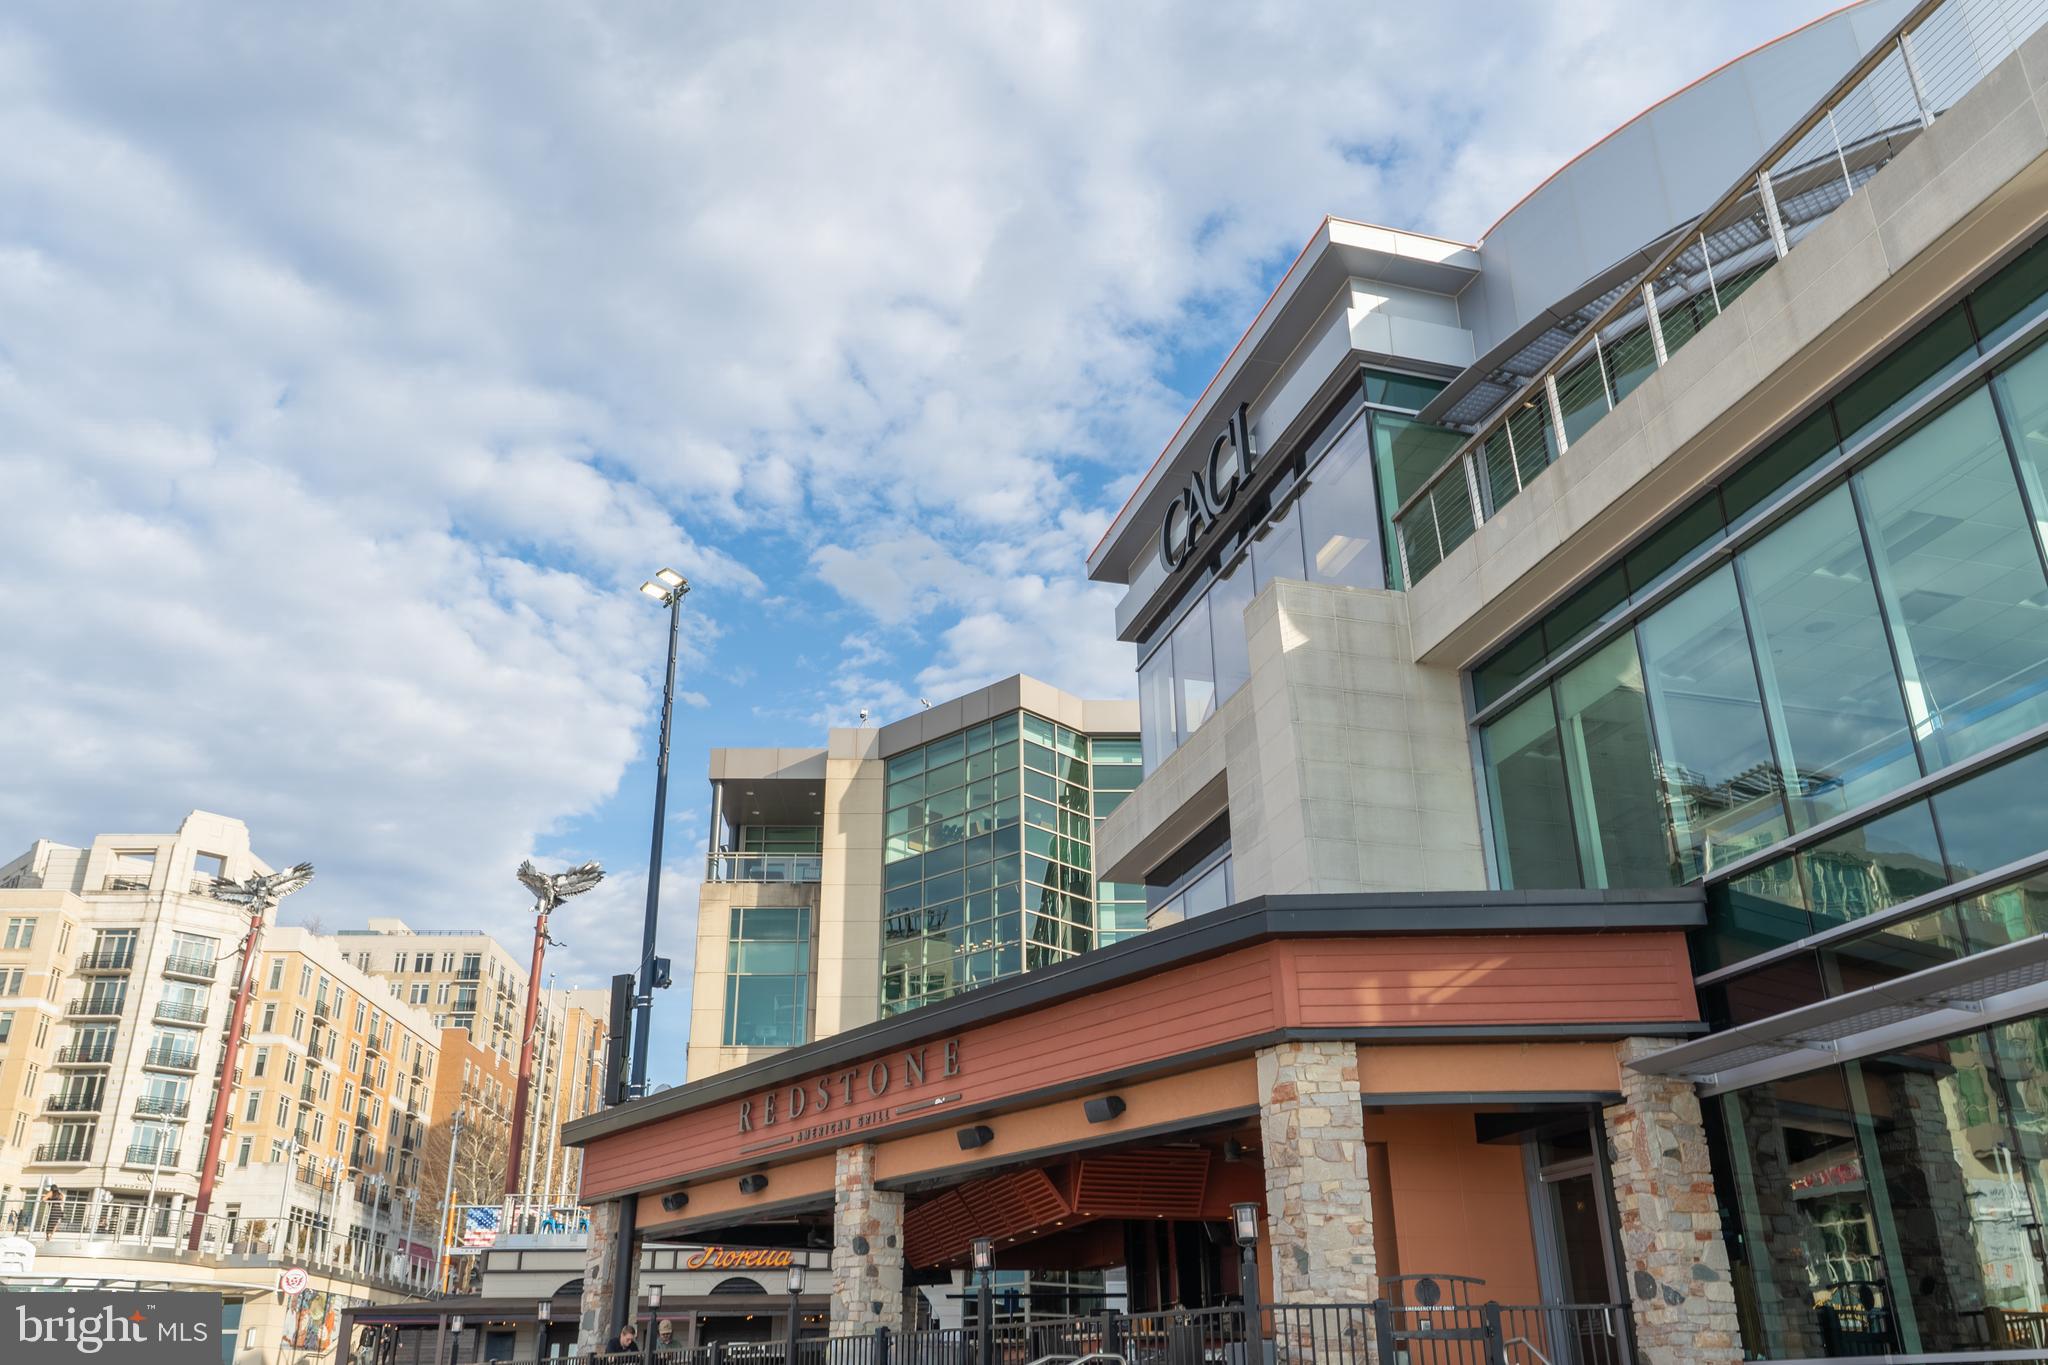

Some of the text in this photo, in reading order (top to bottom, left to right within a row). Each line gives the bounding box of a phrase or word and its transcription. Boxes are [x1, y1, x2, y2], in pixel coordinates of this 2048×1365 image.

[1159, 401, 1256, 574] CACI
[738, 1039, 962, 1134] REDSTONE
[797, 1109, 890, 1142] AMERICAN GRILL
